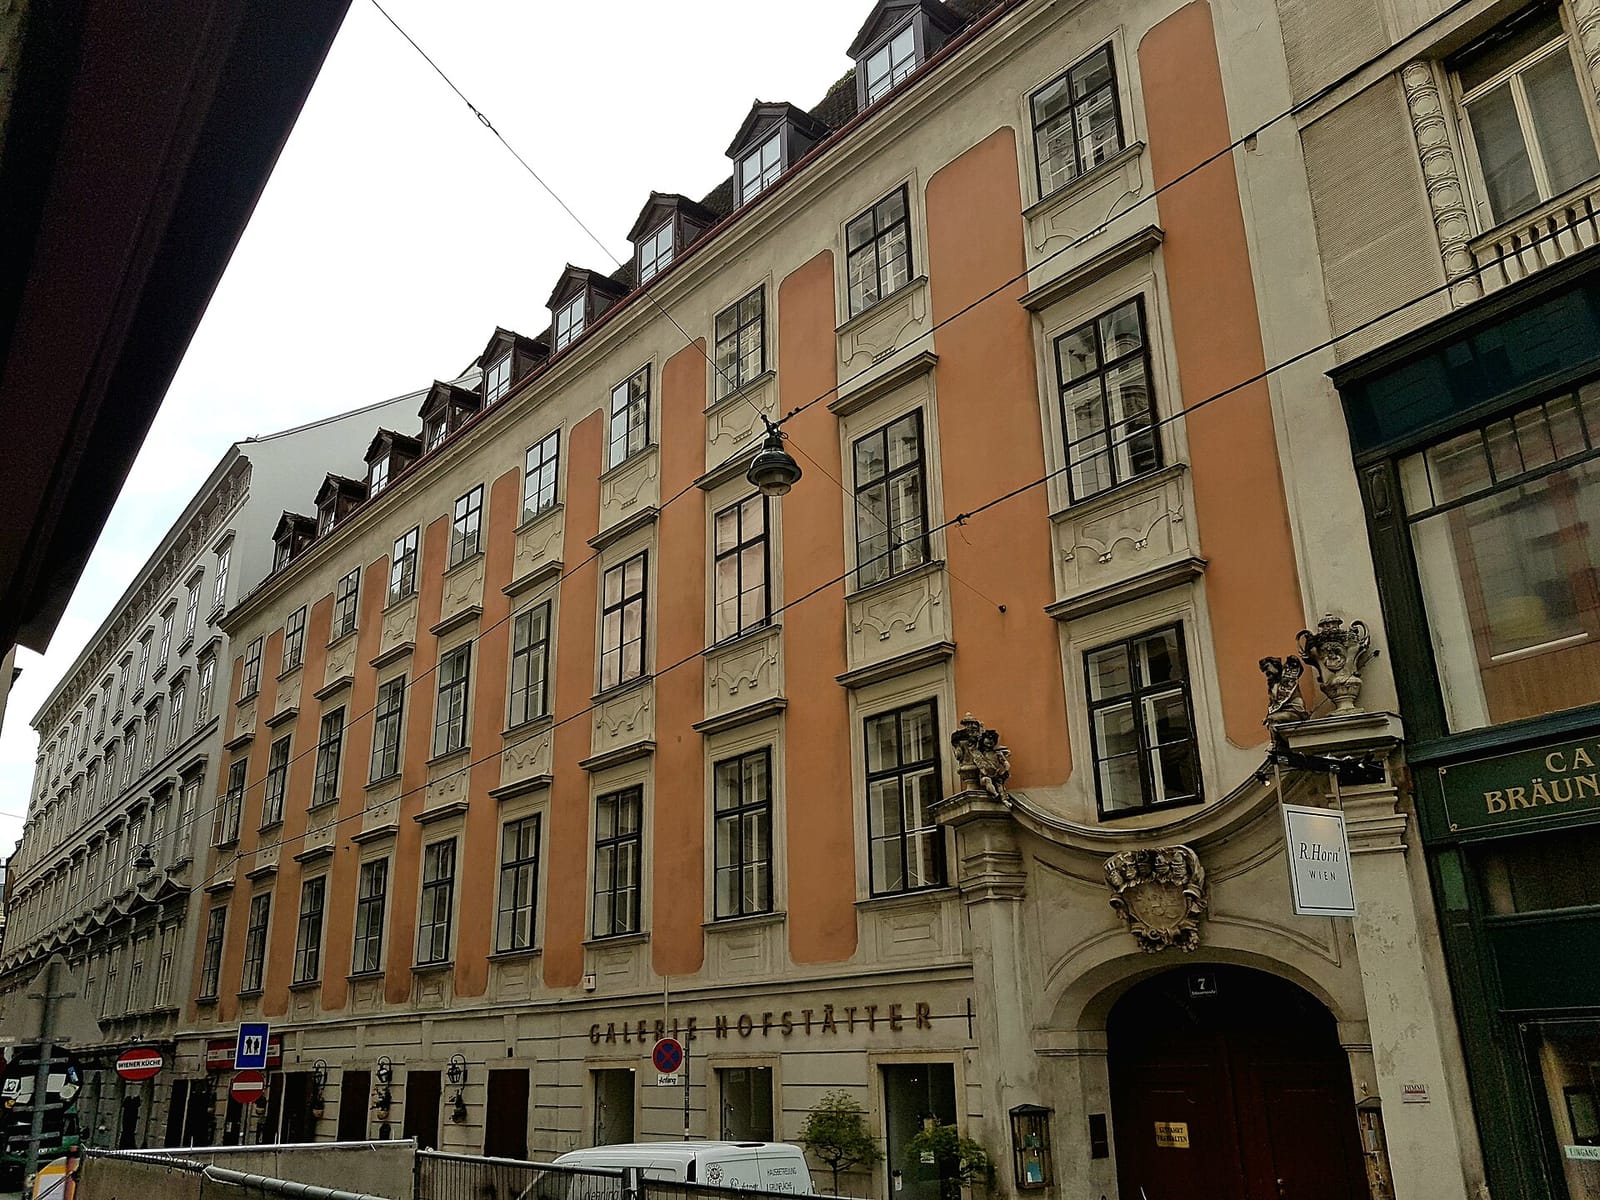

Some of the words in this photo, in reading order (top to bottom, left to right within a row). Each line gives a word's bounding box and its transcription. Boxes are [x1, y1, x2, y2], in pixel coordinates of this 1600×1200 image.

[1545, 744, 1600, 772] CA
[1309, 870, 1336, 881] WIEN
[1198, 978, 1206, 990] 7
[589, 1017, 697, 1044] GALERIE
[715, 1002, 932, 1039] HOFSTÄTTER
[118, 1061, 139, 1069] WIENER
